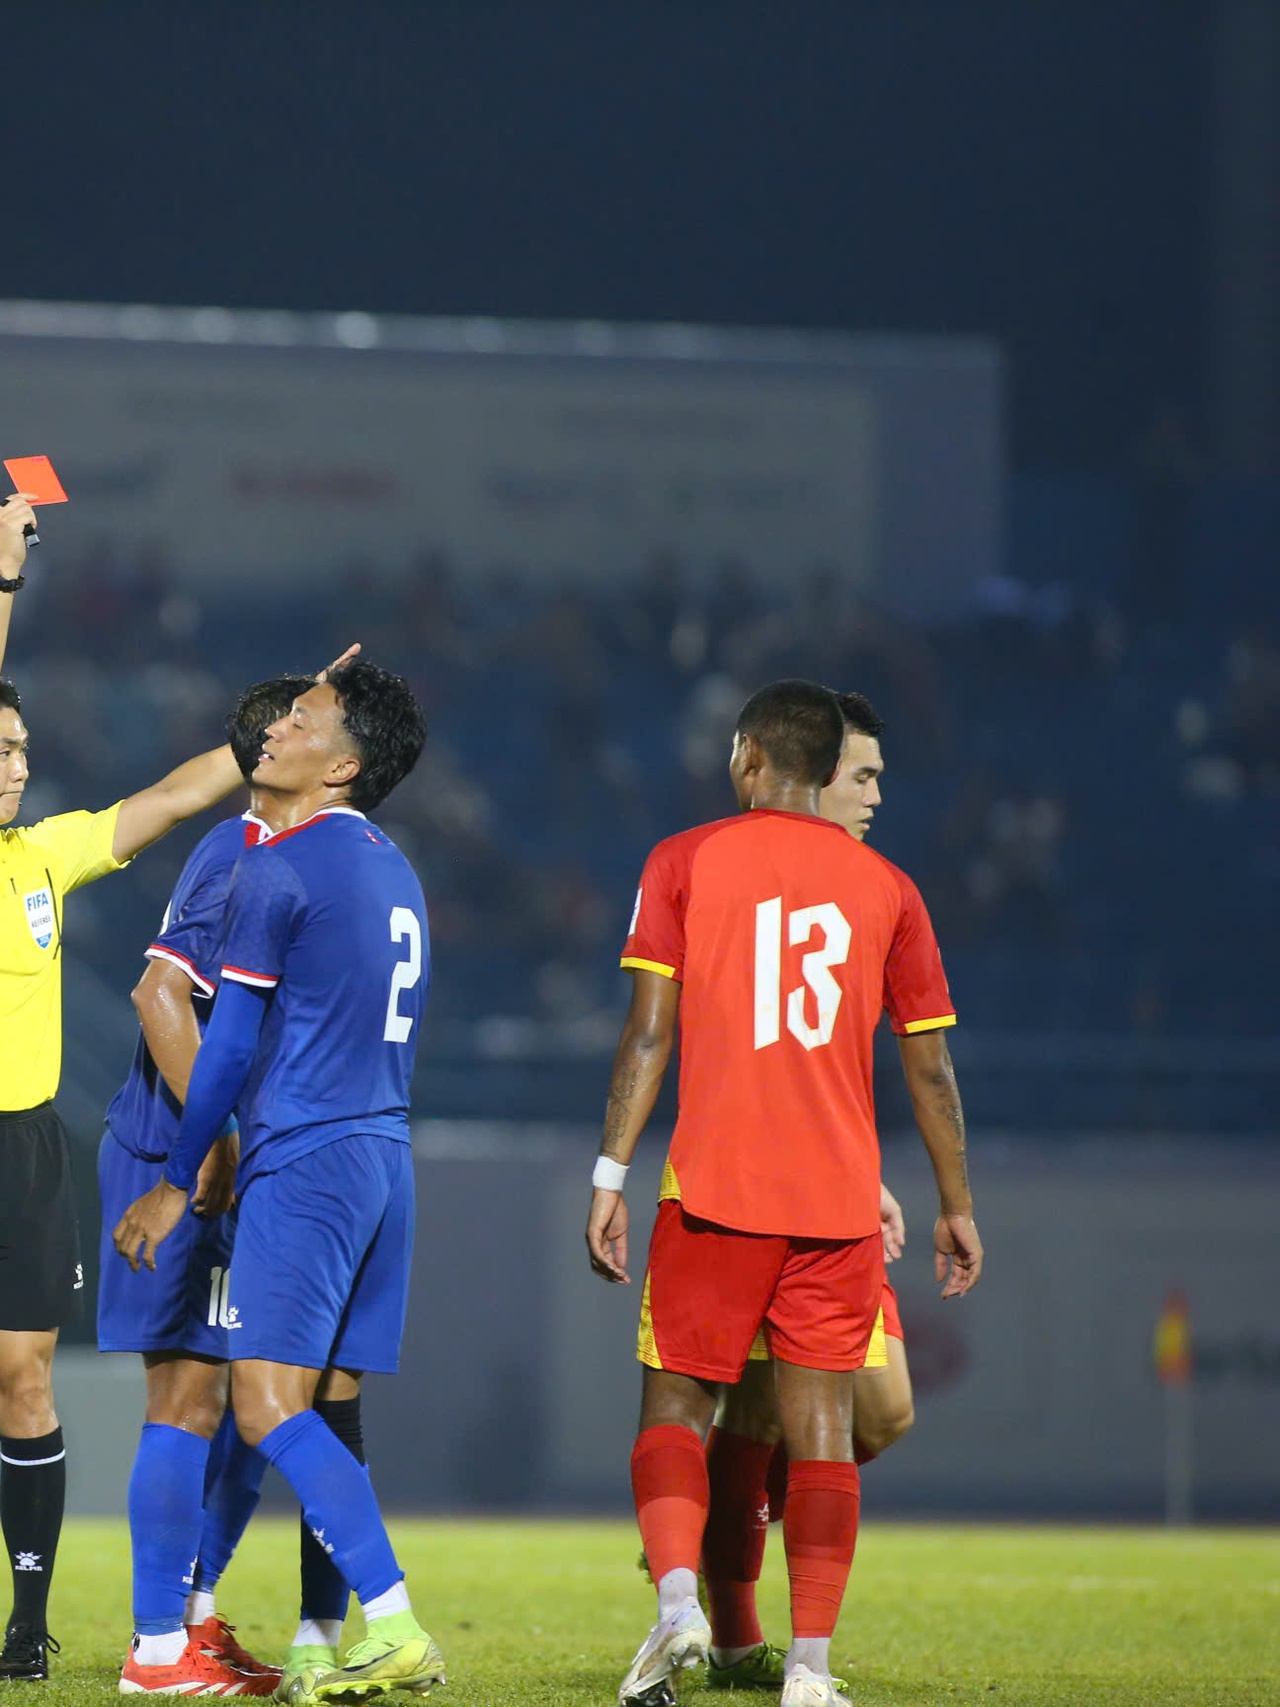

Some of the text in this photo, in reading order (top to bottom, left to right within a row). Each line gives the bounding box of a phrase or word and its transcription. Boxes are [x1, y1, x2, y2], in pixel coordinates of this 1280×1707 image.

[26, 892, 49, 912] FIFA
[383, 907, 423, 1043] 2
[753, 896, 852, 1051] 13
